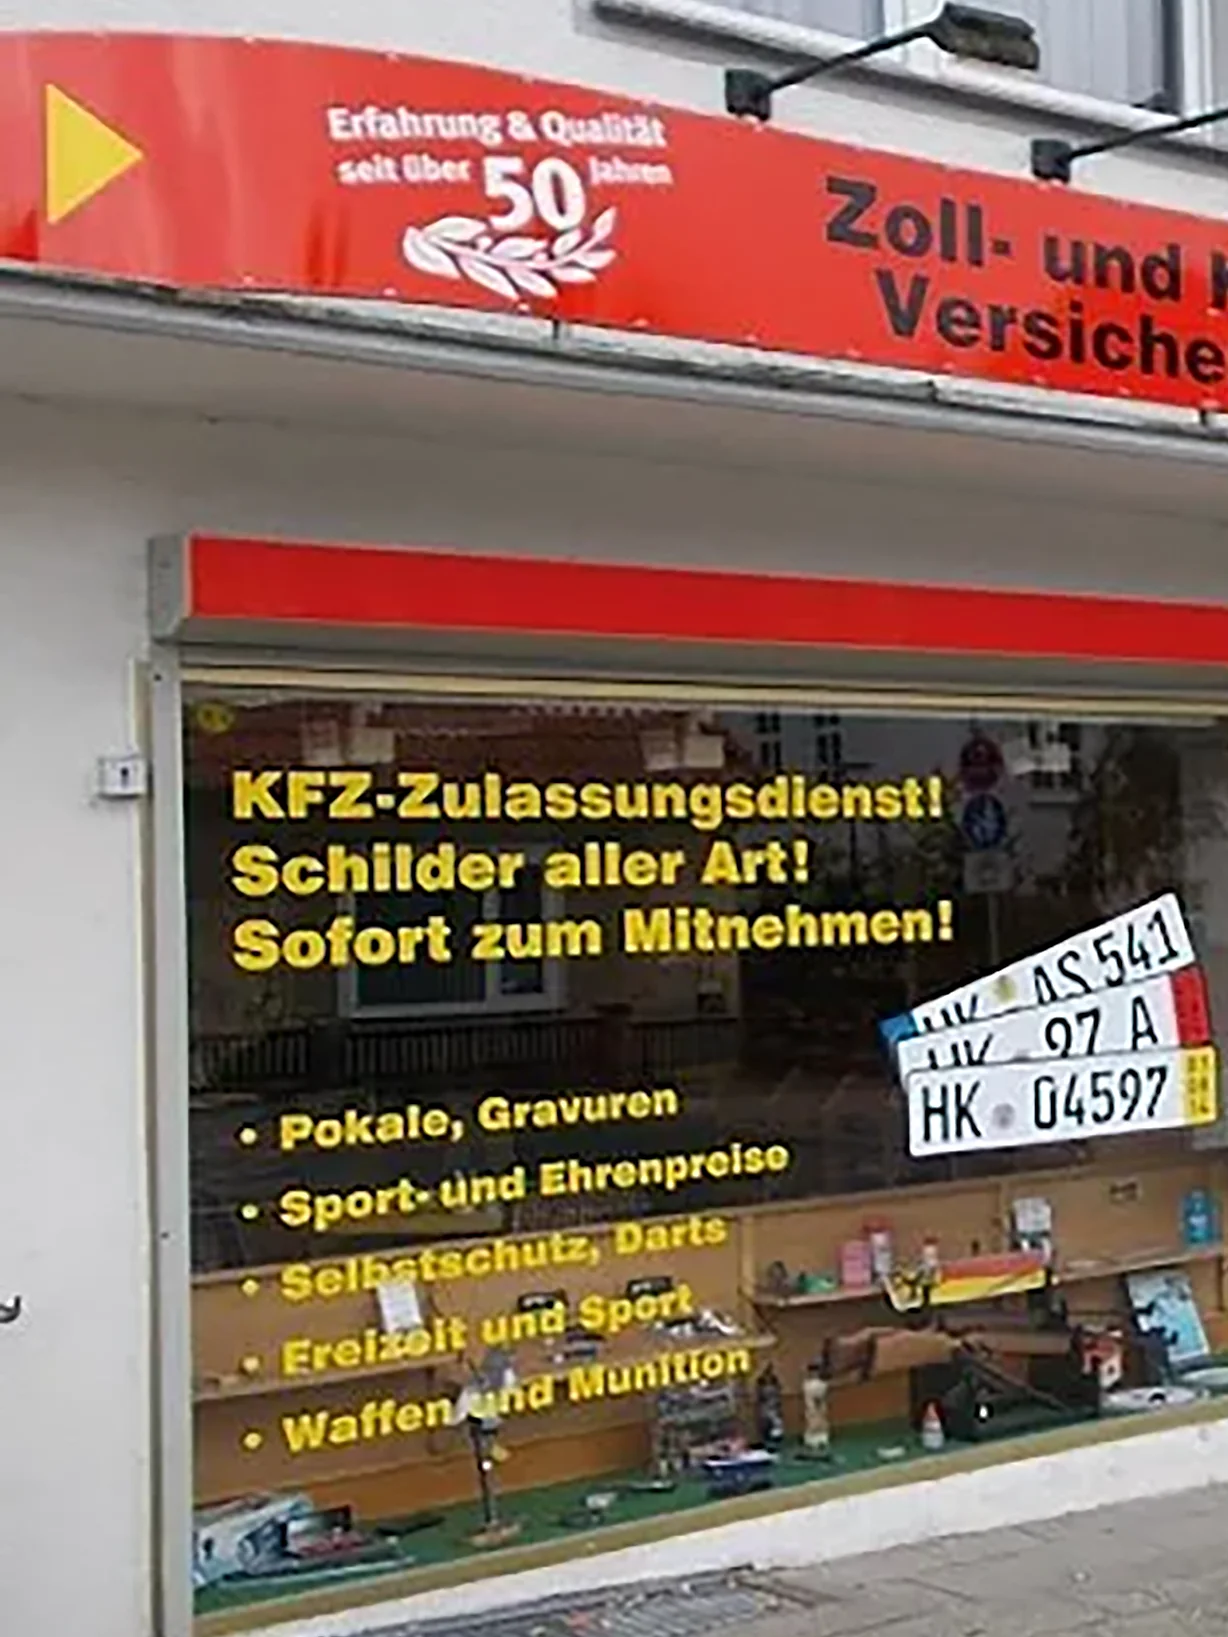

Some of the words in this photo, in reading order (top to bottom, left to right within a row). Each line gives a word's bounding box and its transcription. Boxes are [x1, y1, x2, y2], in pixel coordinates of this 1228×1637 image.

[328, 106, 503, 147] Erfahrung
[506, 110, 538, 142] &
[540, 110, 667, 148] Qualität
[337, 154, 399, 185] seit
[402, 153, 472, 184] über
[482, 156, 588, 232] 50
[826, 177, 1011, 267] Zoll-
[1043, 234, 1182, 302] und
[233, 770, 942, 830] KFZ-Zulassungsdienst!
[233, 844, 525, 897] Schilder
[545, 842, 685, 889] aller
[702, 840, 809, 885] Art!
[233, 916, 452, 972] Sofort
[472, 920, 603, 960] zum
[624, 901, 954, 954] Mitnehmen!
[1094, 910, 1179, 987] 541
[1045, 1007, 1101, 1058] 97
[1131, 996, 1158, 1050] A
[280, 1105, 464, 1151] Pokale,
[478, 1086, 678, 1131] Gravuren
[922, 1081, 982, 1142] HK
[1033, 1066, 1168, 1130] 04597
[280, 1179, 430, 1230] Sport-
[438, 1165, 526, 1204] und
[541, 1141, 790, 1198] Ehrenpreise
[280, 1235, 601, 1301] Selbstschutz,
[615, 1213, 728, 1255] Darts
[281, 1318, 467, 1377] Freizeit
[482, 1301, 566, 1343] und
[579, 1283, 693, 1333] Sport
[283, 1399, 453, 1453] Waffen
[466, 1372, 555, 1416] und
[569, 1347, 751, 1400] Munition
